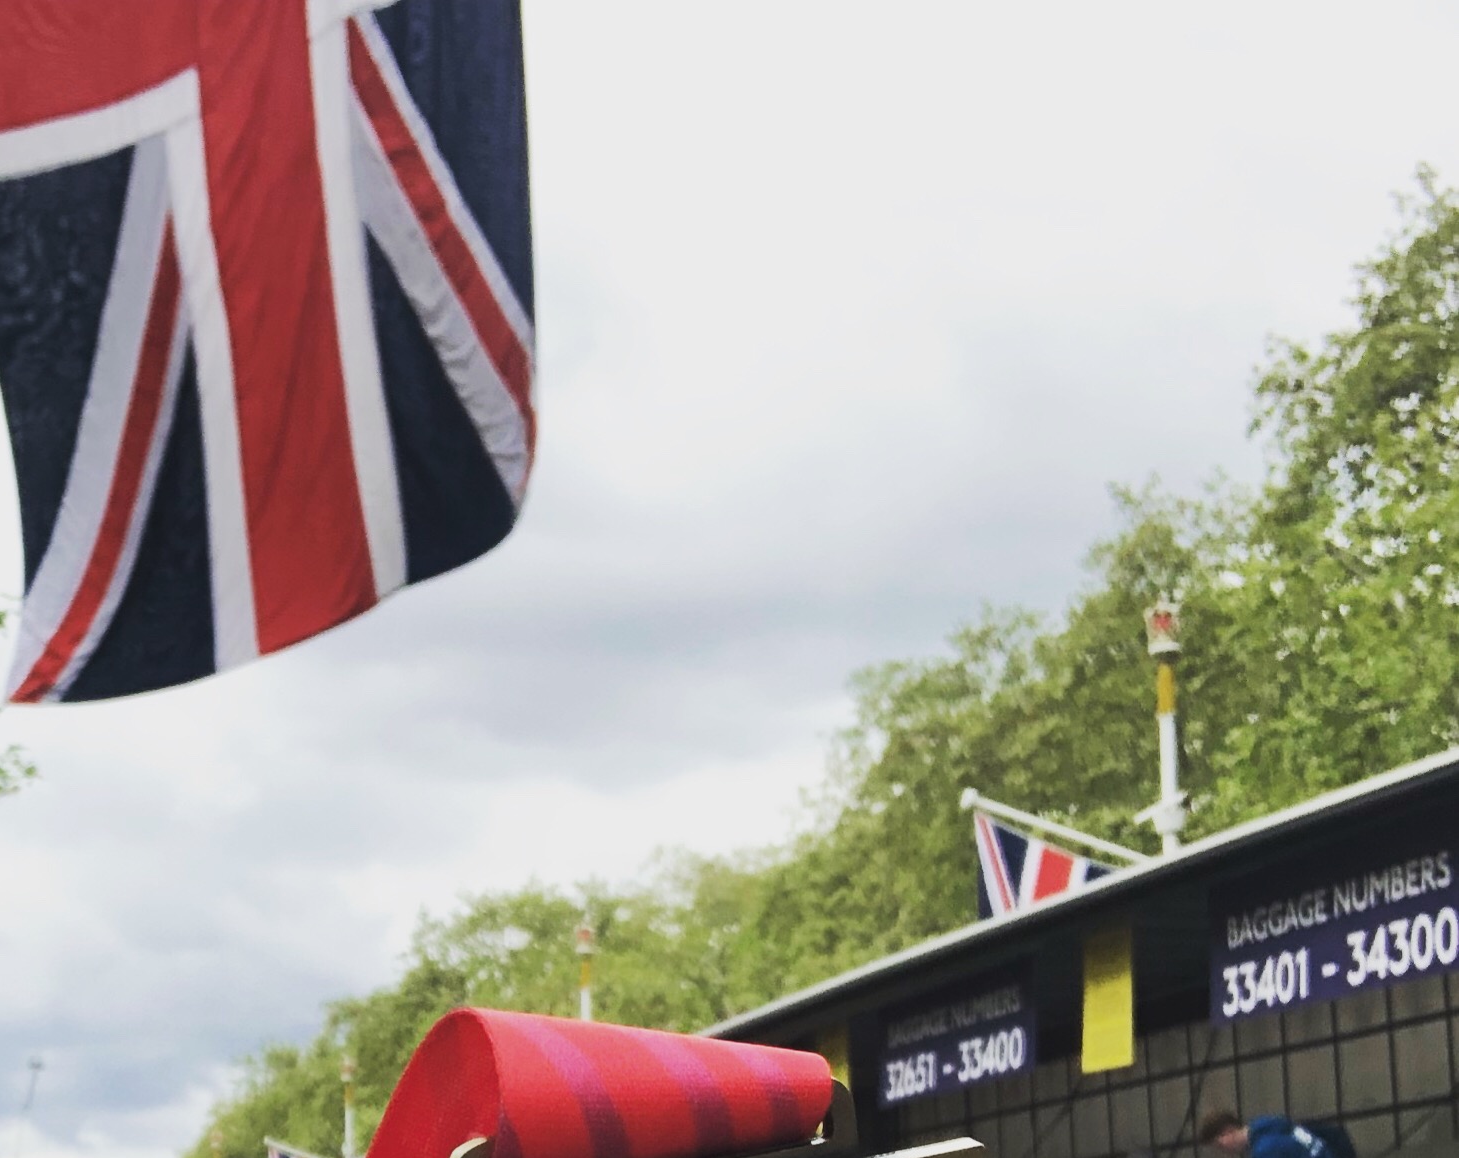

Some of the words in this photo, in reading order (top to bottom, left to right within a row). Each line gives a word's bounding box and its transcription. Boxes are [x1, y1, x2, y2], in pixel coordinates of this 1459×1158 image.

[1227, 889, 1329, 950] BAGGAGE
[1333, 852, 1451, 918] NUMBERS
[1222, 946, 1310, 1018] 33401
[1346, 906, 1459, 987] 34300
[958, 1026, 1025, 1083] 33400
